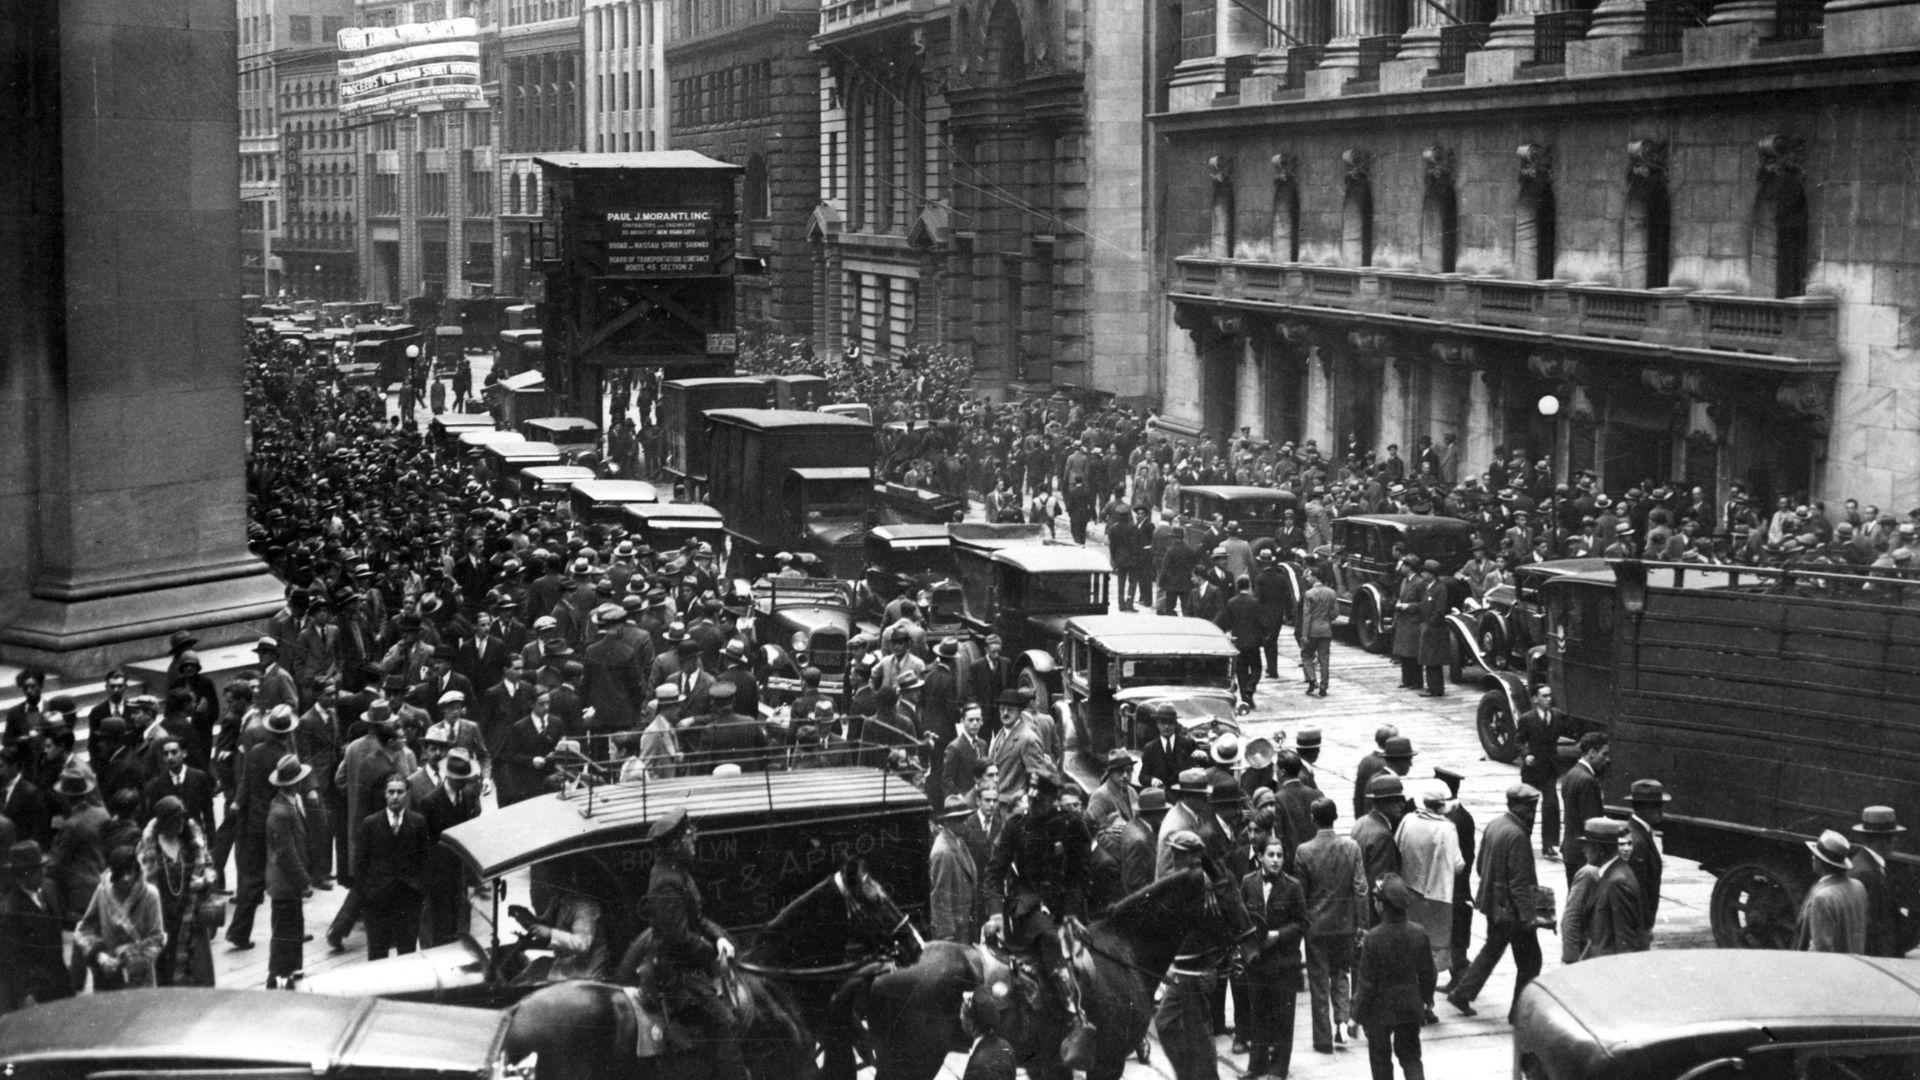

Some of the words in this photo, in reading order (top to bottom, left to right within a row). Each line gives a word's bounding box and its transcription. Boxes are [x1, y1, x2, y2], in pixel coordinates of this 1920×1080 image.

[341, 77, 379, 97] PROCEEDS
[381, 73, 396, 86] FOR
[607, 212, 632, 221] PAUL
[690, 211, 711, 220] INC.
[661, 241, 682, 249] STREET
[636, 255, 682, 263] TRANSPORTATION
[740, 864, 764, 893] &
[779, 823, 903, 881] APRON
